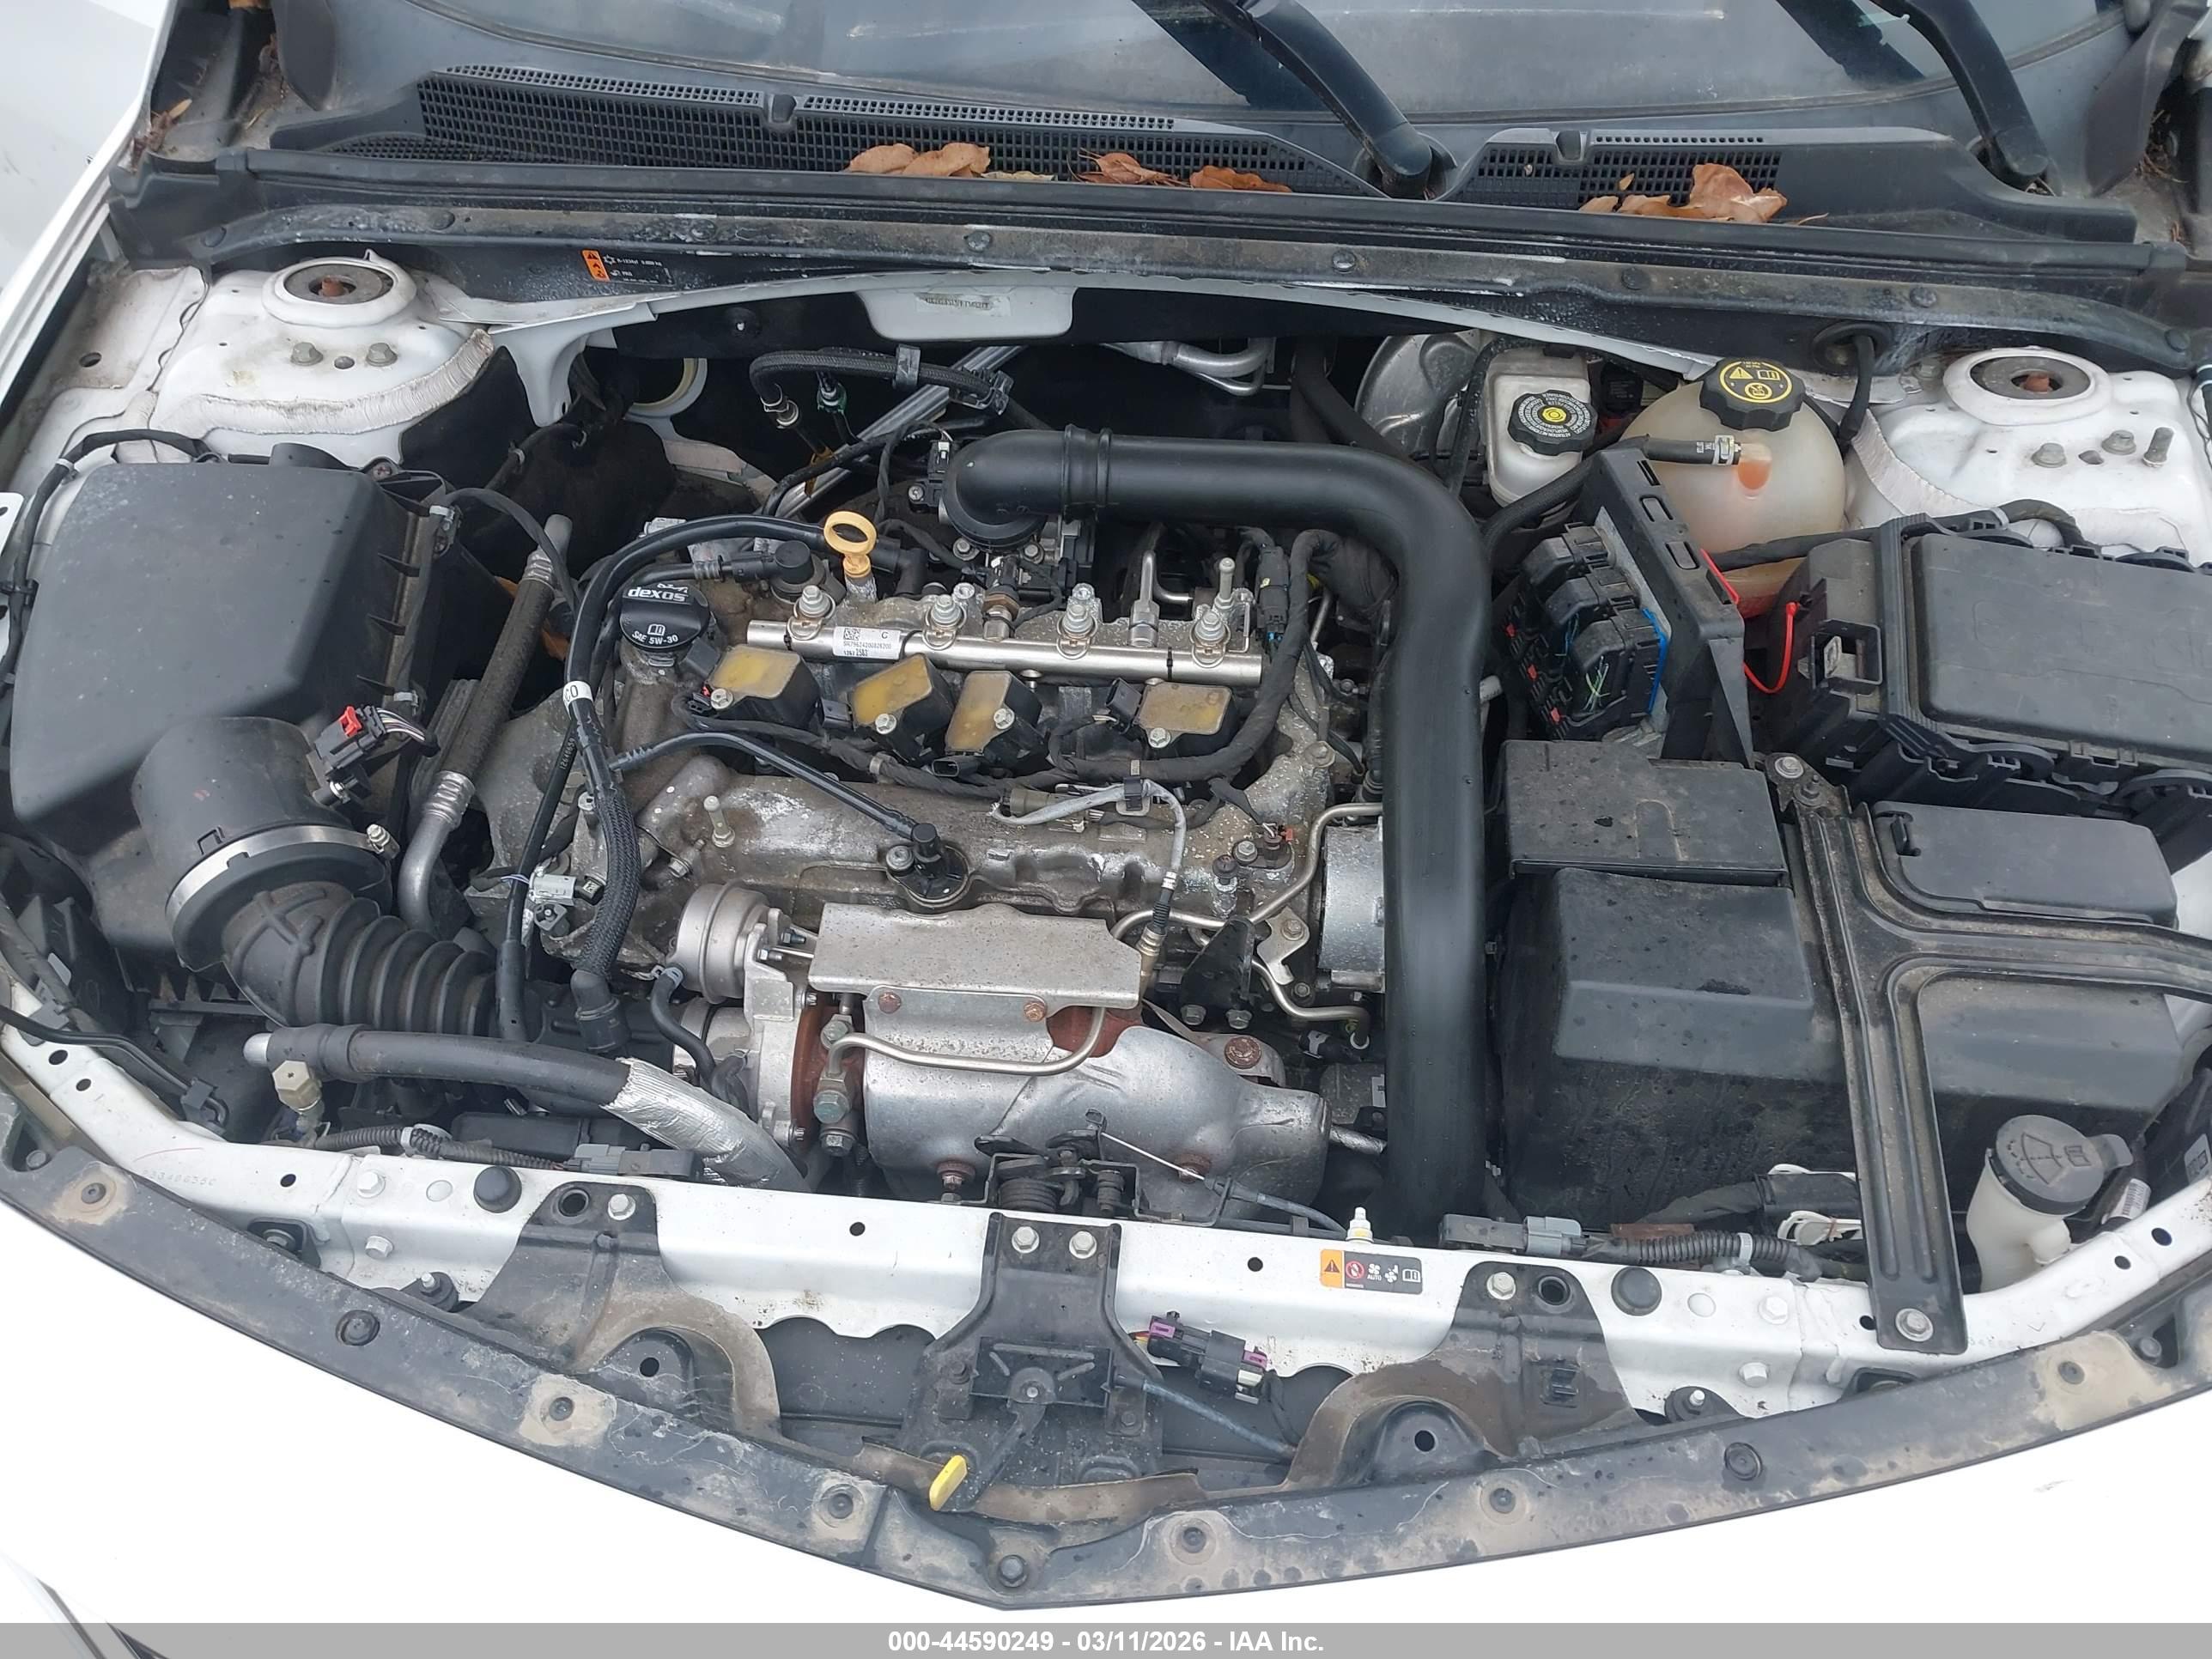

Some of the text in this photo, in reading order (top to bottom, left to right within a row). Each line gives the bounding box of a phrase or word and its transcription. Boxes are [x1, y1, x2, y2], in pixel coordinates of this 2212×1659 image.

[628, 586, 689, 602] dexos
[631, 630, 678, 645] SAE 5W-30
